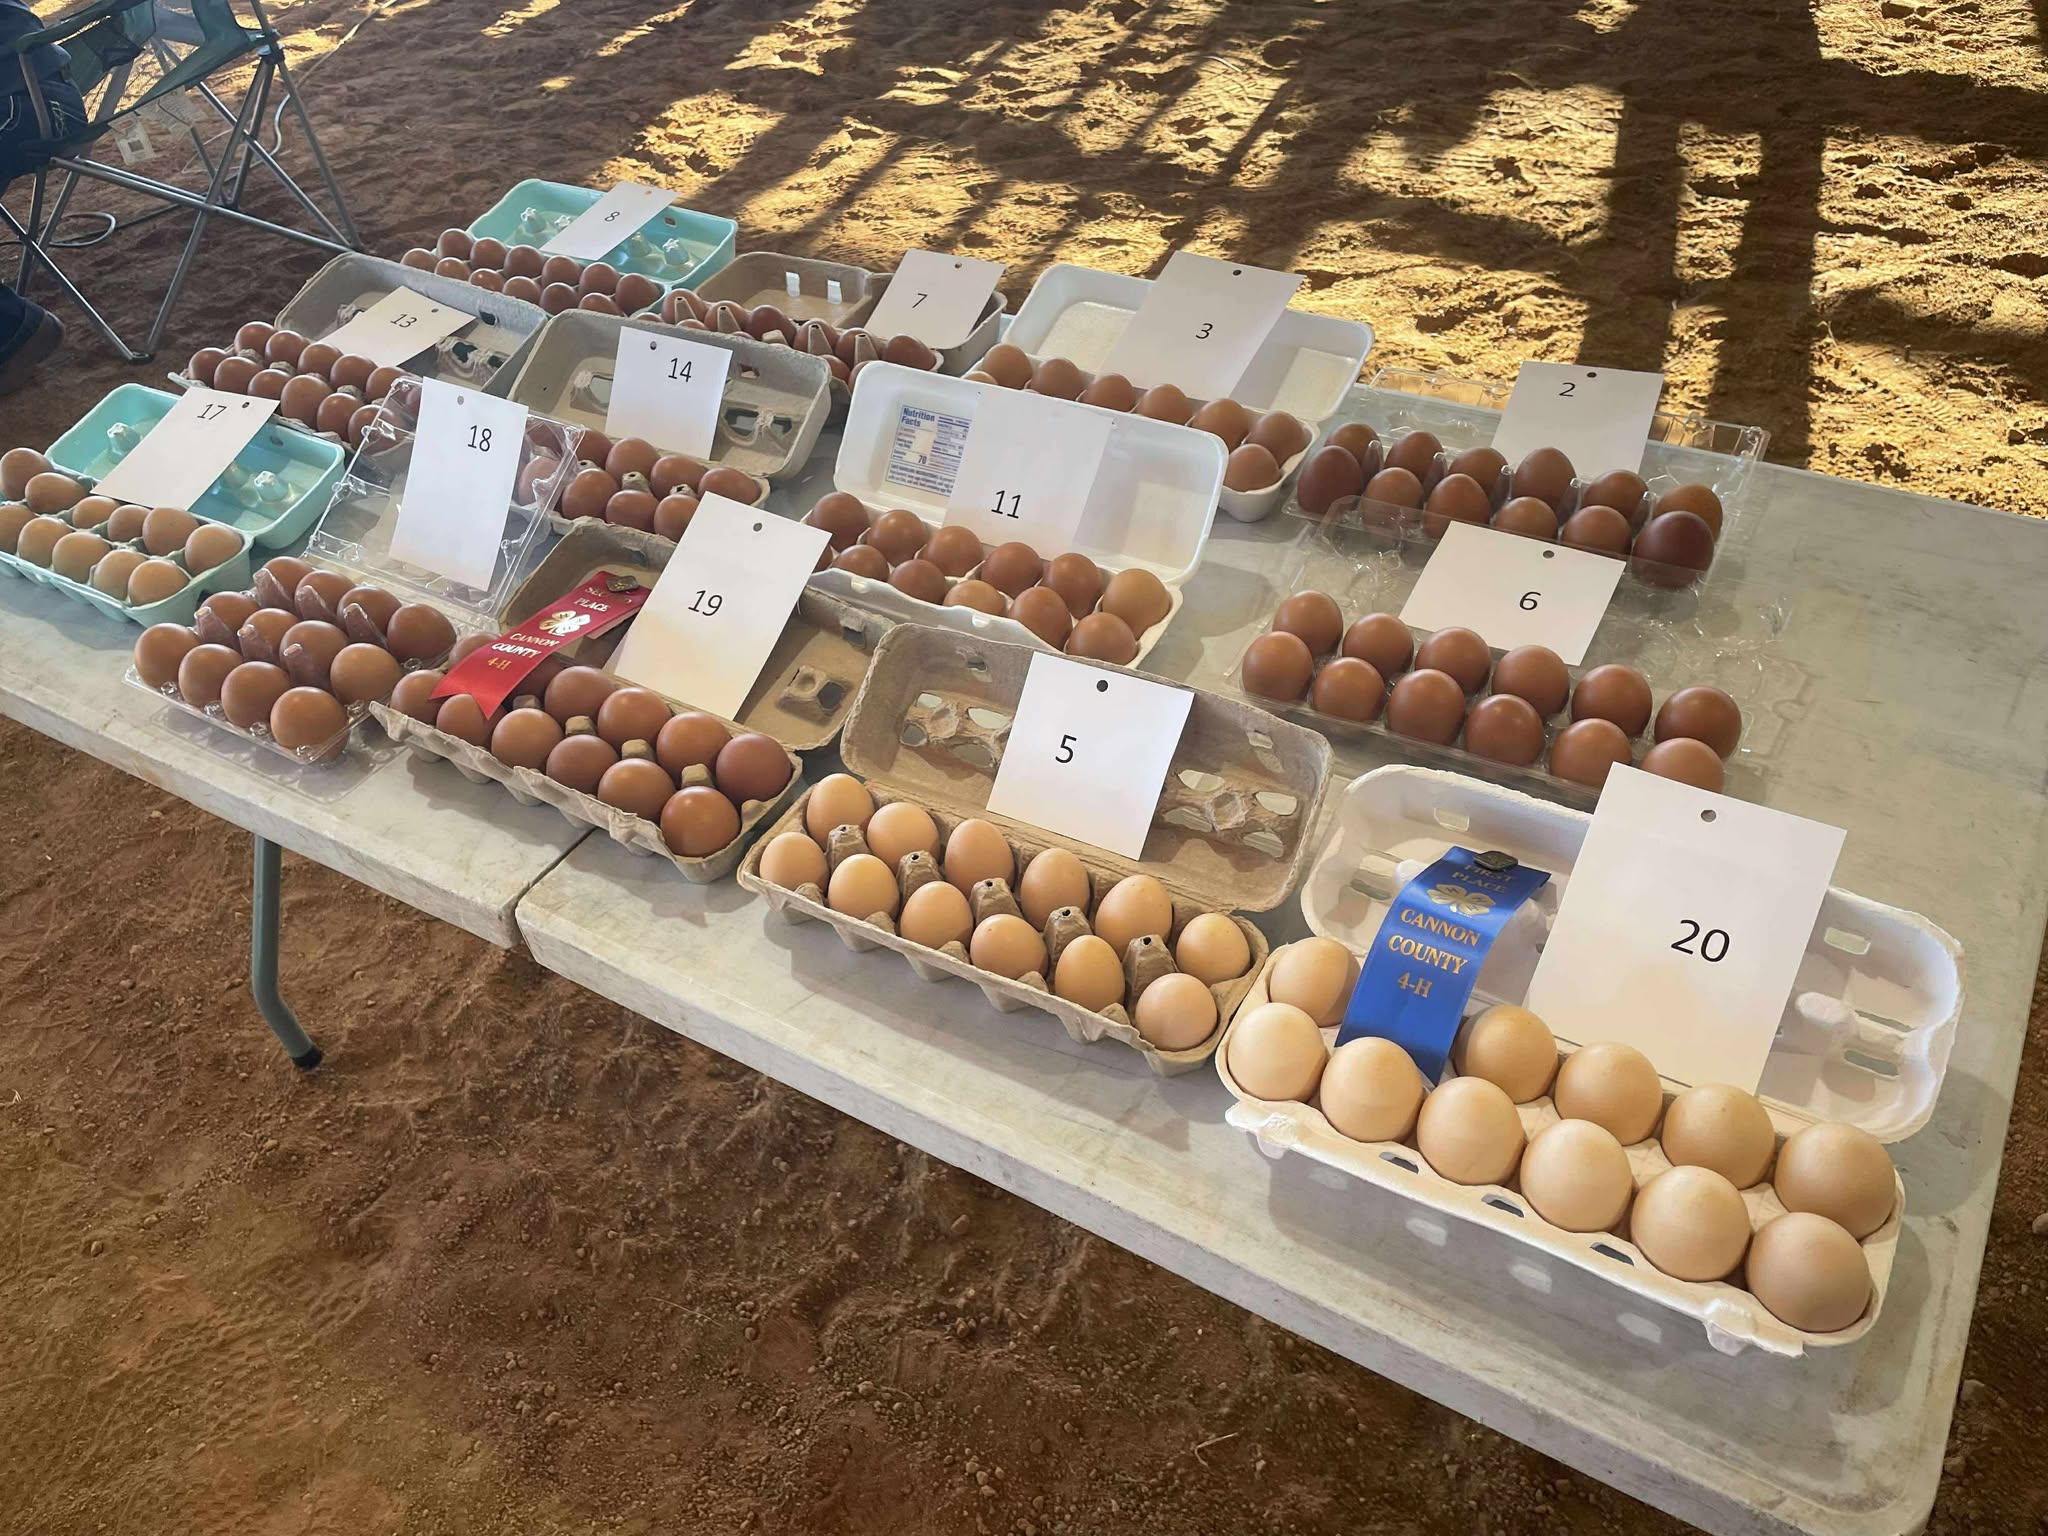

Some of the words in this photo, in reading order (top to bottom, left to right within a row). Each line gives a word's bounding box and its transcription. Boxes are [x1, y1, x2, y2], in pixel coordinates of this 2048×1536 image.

[604, 211, 621, 222] 8
[912, 292, 928, 308] 7
[390, 312, 417, 328] 13
[1195, 322, 1213, 340] 3
[667, 357, 693, 383] 14
[1558, 382, 1576, 398] 2
[196, 402, 228, 422] 17
[901, 416, 921, 427] Facts
[903, 407, 936, 422] Nutrition
[466, 424, 493, 453] 18
[990, 489, 1022, 520] 11
[574, 597, 612, 612] PLACE
[687, 588, 723, 617] 19
[1518, 590, 1542, 612] 6
[509, 632, 560, 648] CANNON
[491, 642, 543, 659] COUNTY
[487, 656, 512, 671] 4-H
[1054, 734, 1078, 764] 5
[1451, 872, 1510, 894] PLACE
[1400, 907, 1482, 947] CANNON
[1670, 918, 1731, 963] 20
[1388, 934, 1469, 975] COUNTY
[1397, 971, 1434, 999] 4-H
